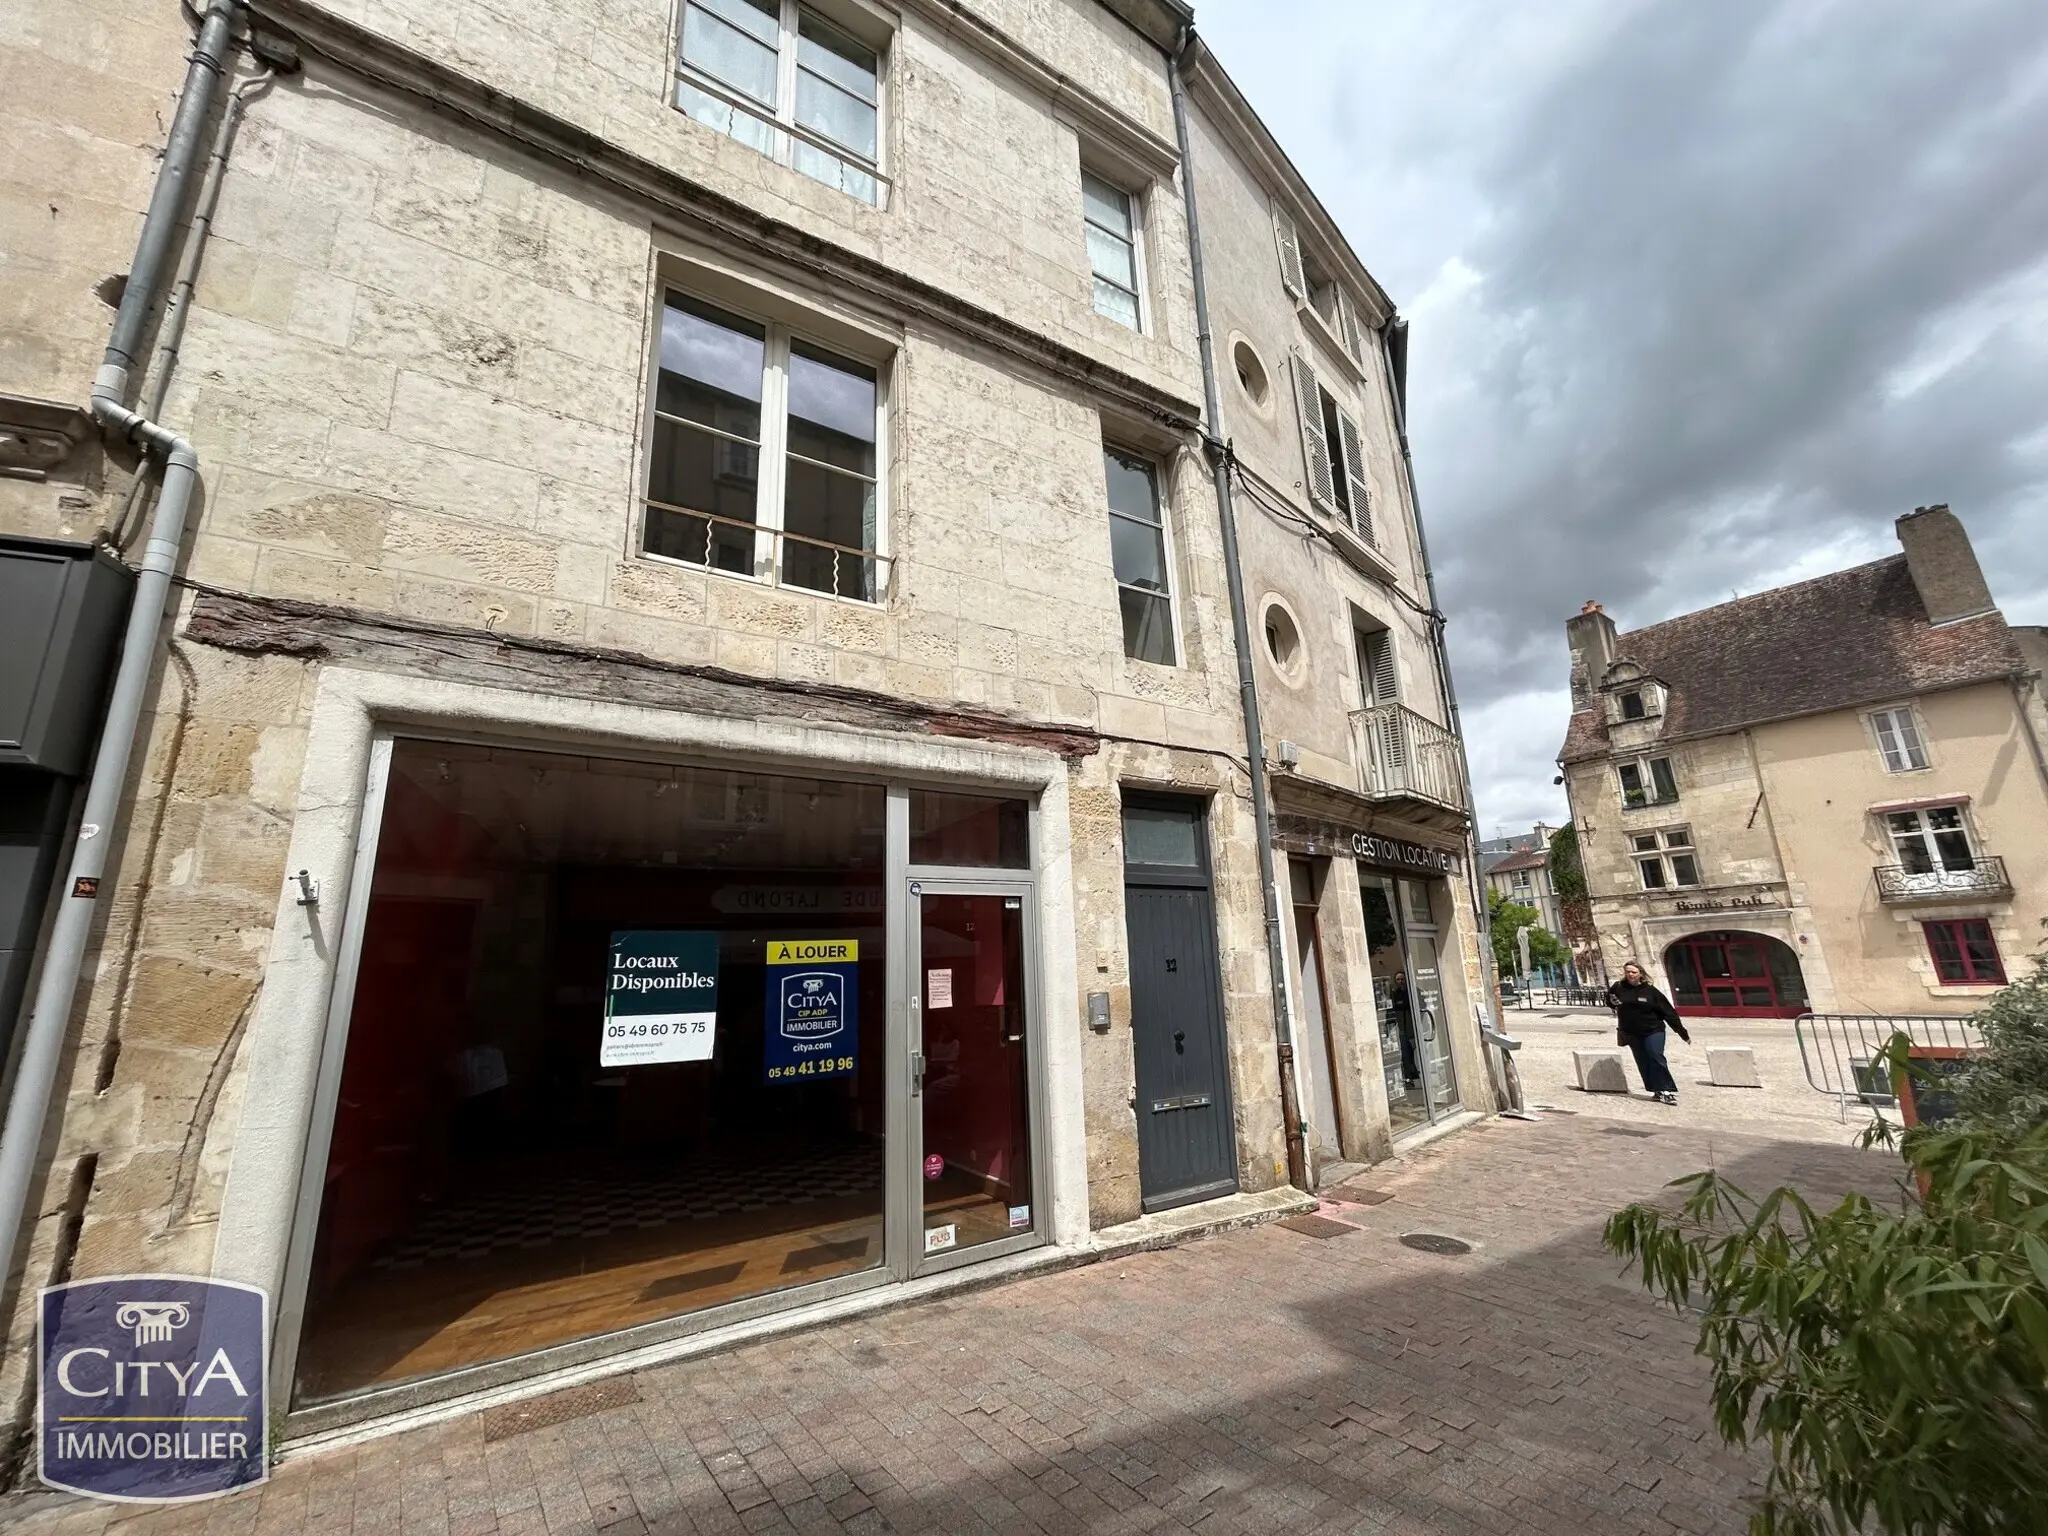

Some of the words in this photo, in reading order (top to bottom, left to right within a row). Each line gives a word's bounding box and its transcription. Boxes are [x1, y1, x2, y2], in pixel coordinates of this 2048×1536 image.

[1351, 833, 1401, 861] GESTION
[1401, 844, 1449, 871] LOCATIVE
[778, 943, 791, 960] À
[796, 945, 848, 959] LOUER
[613, 953, 679, 969] Locaux
[611, 972, 715, 994] Disponibles
[812, 1008, 828, 1016] ADP
[608, 1026, 626, 1038] 05
[629, 1024, 647, 1036] 49
[650, 1023, 669, 1036] 60
[672, 1022, 688, 1035] 75
[690, 1021, 706, 1033] 75
[787, 1019, 838, 1032] IMMOBILIER
[792, 1041, 832, 1053] citya.com
[768, 1067, 781, 1078] 05
[783, 1066, 796, 1077] 49
[798, 1060, 816, 1075] 41
[818, 1058, 834, 1073] 19
[837, 1056, 854, 1071] 96
